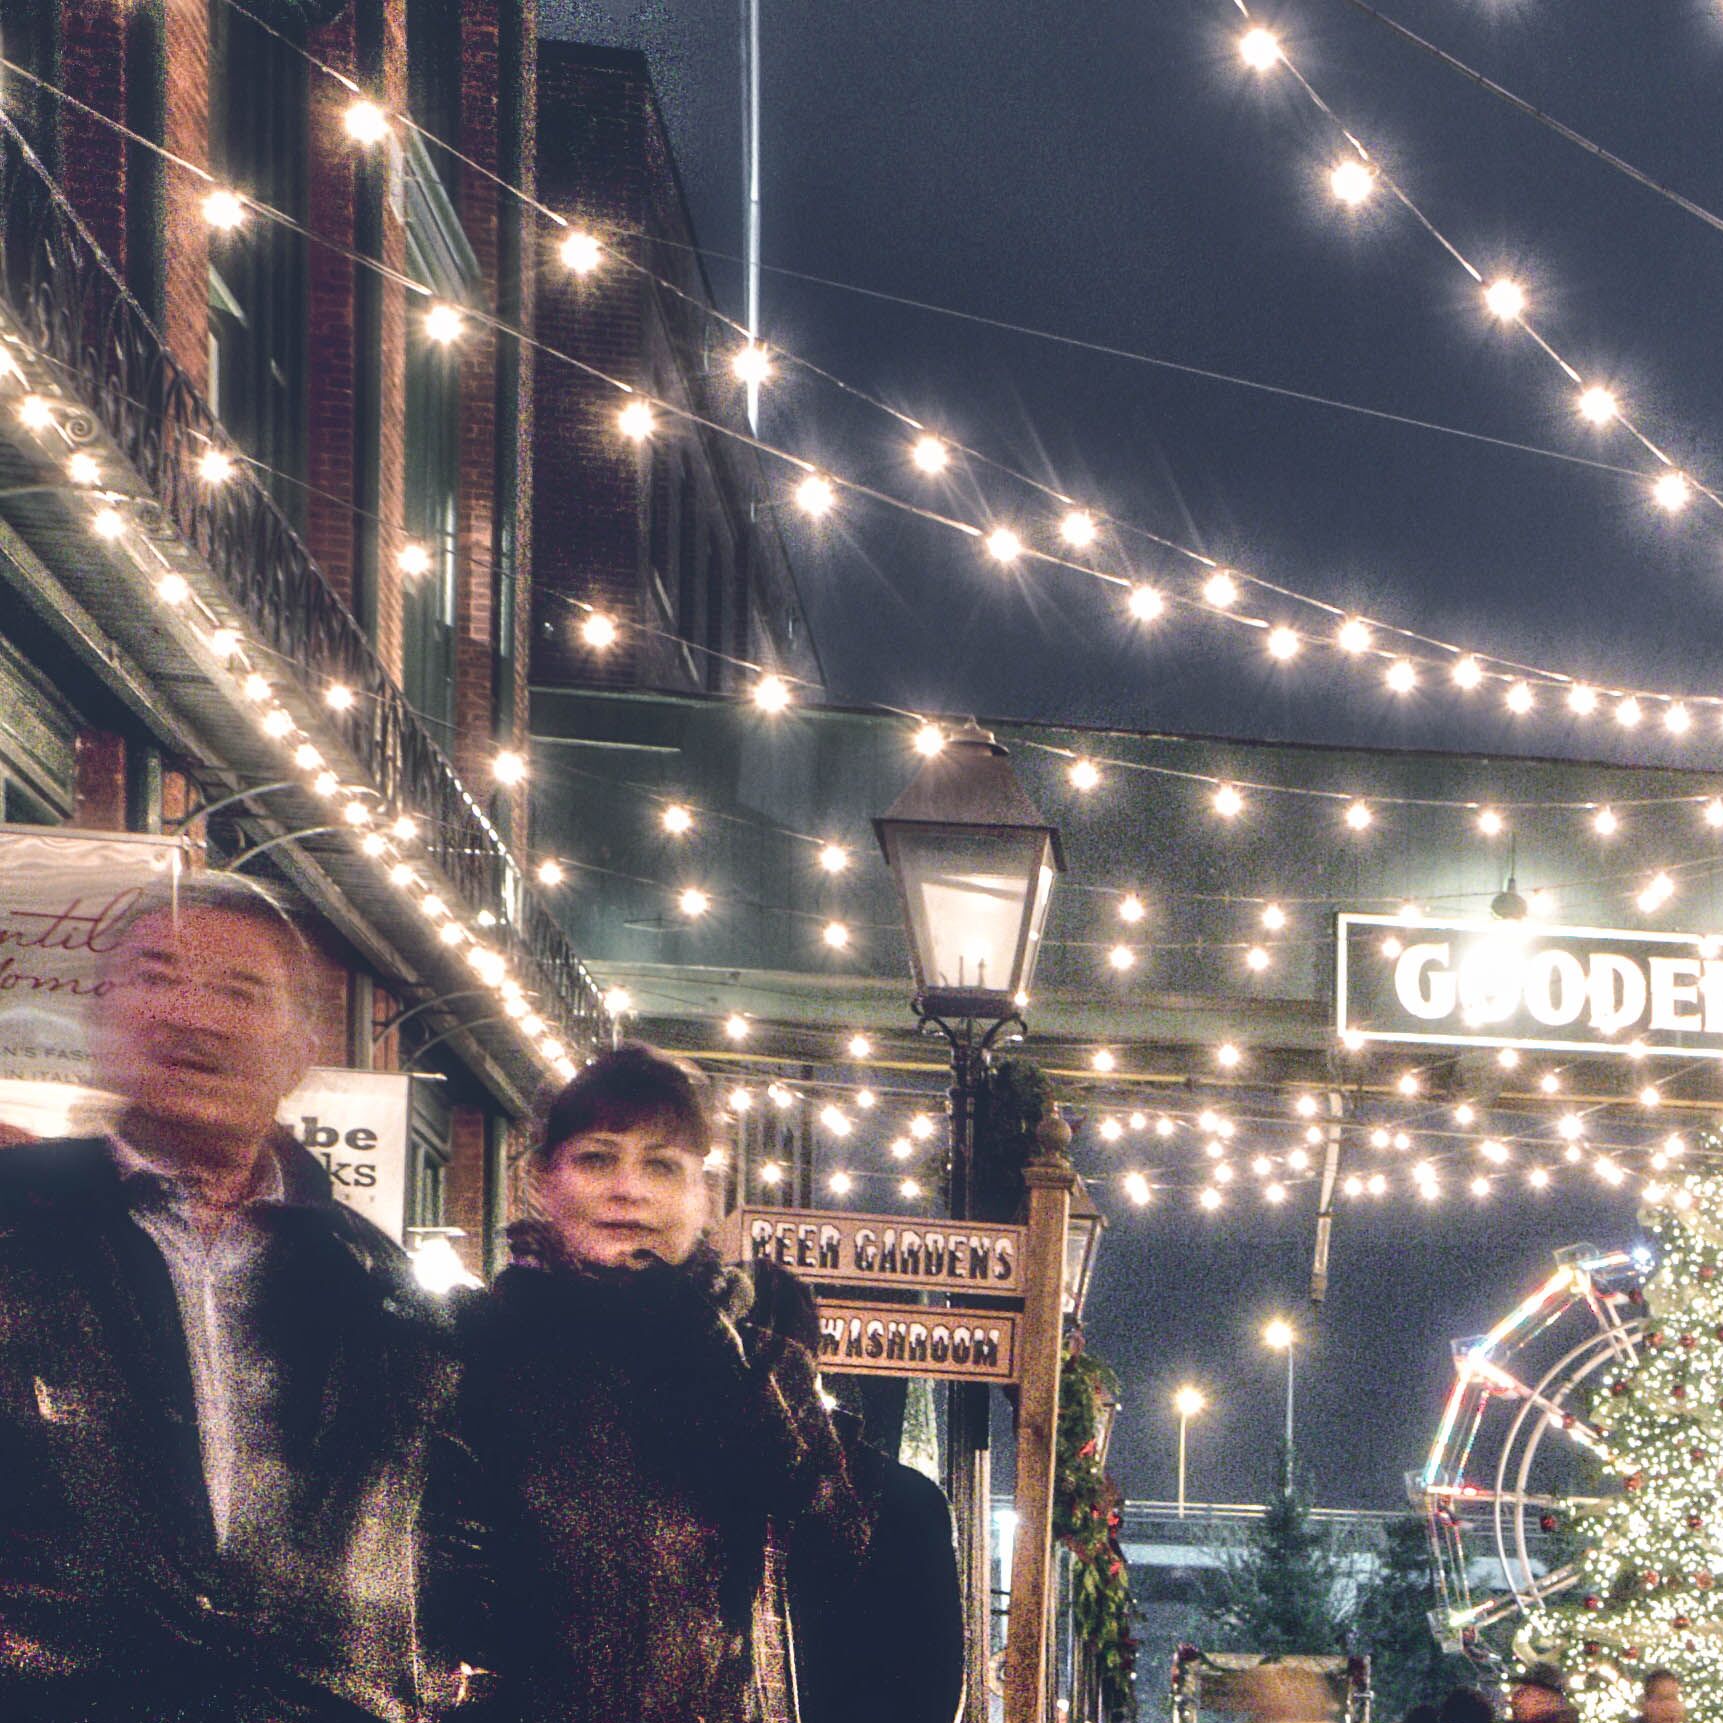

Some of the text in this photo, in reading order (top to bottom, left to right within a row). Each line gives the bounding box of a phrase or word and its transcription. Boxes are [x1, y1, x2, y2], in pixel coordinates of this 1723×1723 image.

[284, 1116, 378, 1150] be
[751, 1219, 1013, 1281] BEER GARDENS
[820, 1317, 999, 1367] WASHROOM
